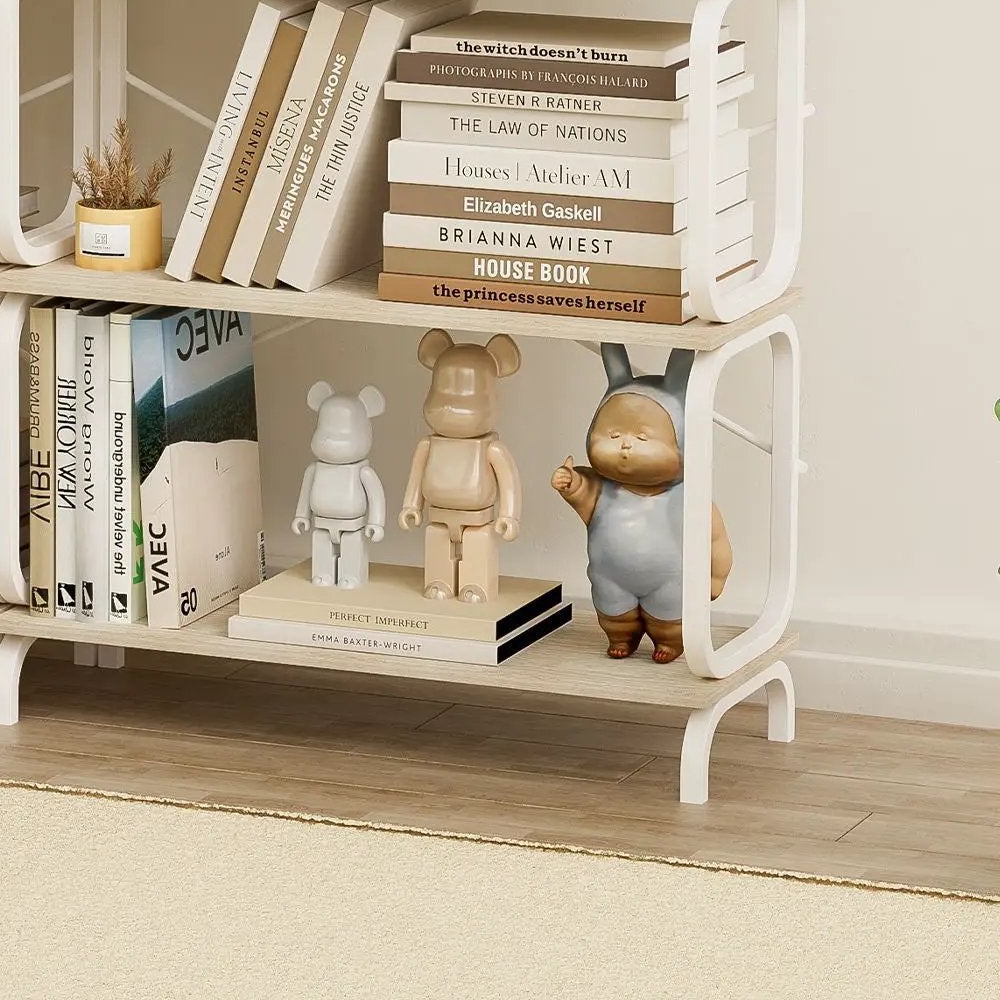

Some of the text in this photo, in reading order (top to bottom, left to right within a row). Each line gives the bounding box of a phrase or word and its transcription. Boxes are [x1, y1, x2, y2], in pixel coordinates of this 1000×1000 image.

[429, 64, 648, 88] PHOTOGRAPHS BY FRANÇOIS HALARD
[471, 92, 601, 112] STEVEN R RATNER
[231, 110, 269, 194] INSTANBUL
[275, 53, 347, 234] MERINGUES MACARONS
[473, 258, 591, 285] HOUSE BOOK
[329, 611, 429, 630] PERFECT IMPERFECT
[312, 633, 422, 652] EMMA BAXTER-WRIGHT
